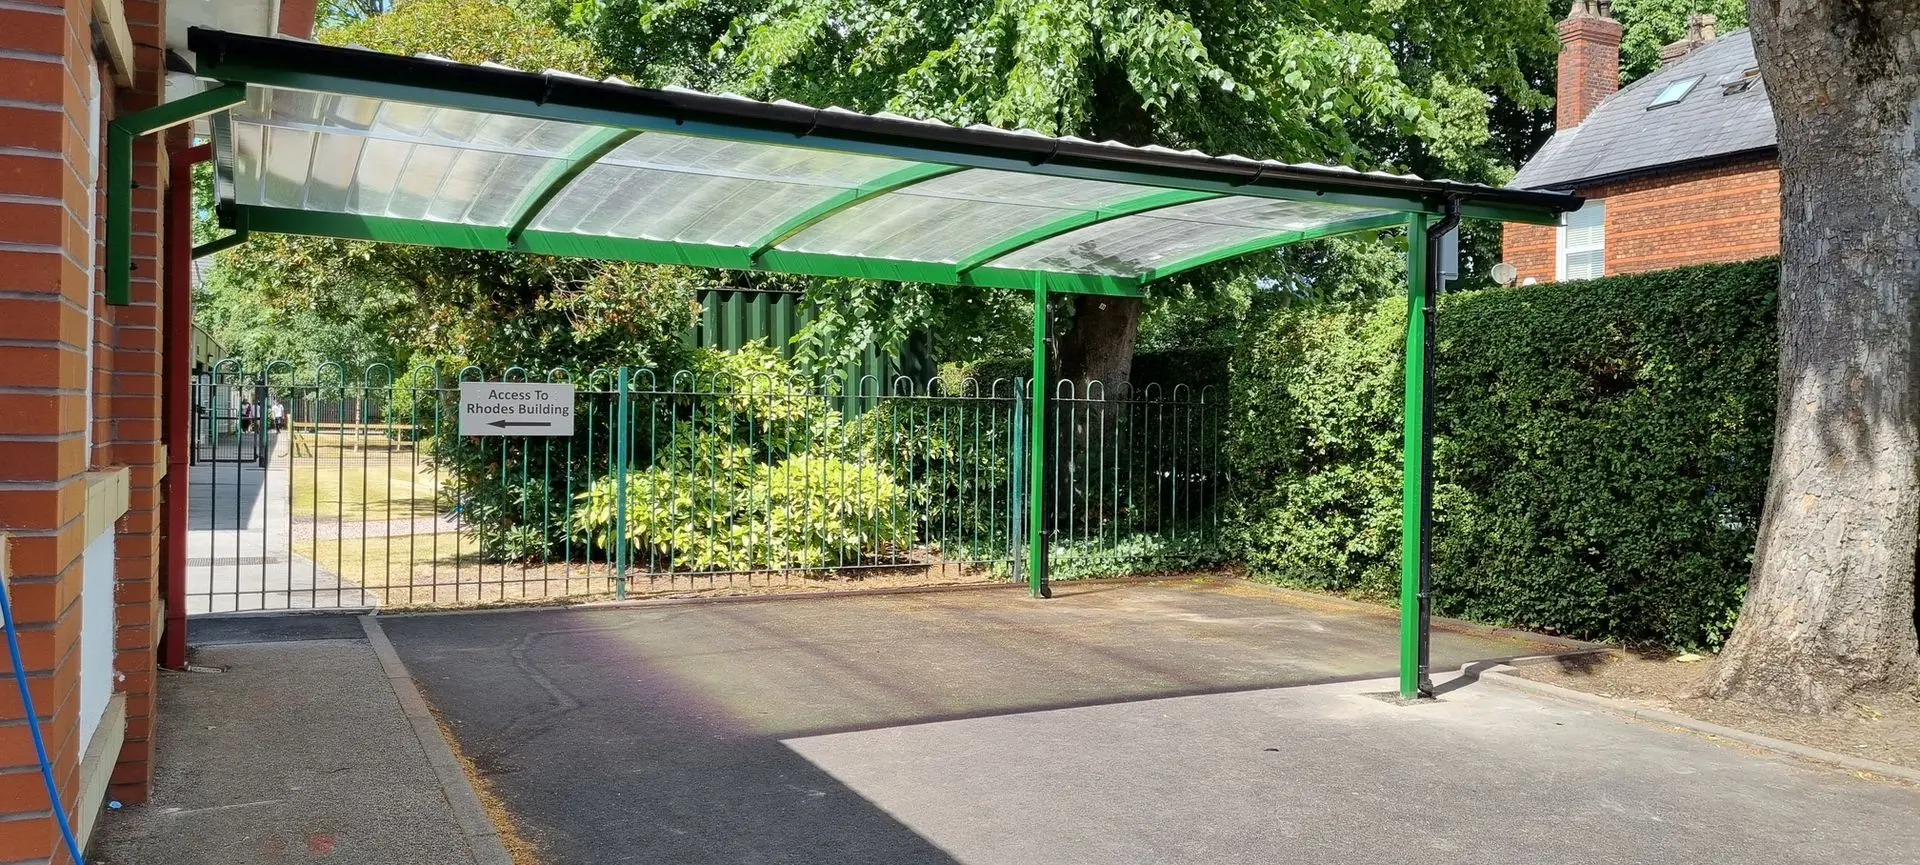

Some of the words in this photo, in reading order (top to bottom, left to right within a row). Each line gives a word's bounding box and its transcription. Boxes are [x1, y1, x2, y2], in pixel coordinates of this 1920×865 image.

[488, 389, 531, 400] Access
[534, 390, 549, 400] To
[467, 403, 515, 414] Rhodes
[518, 403, 570, 417] Building
